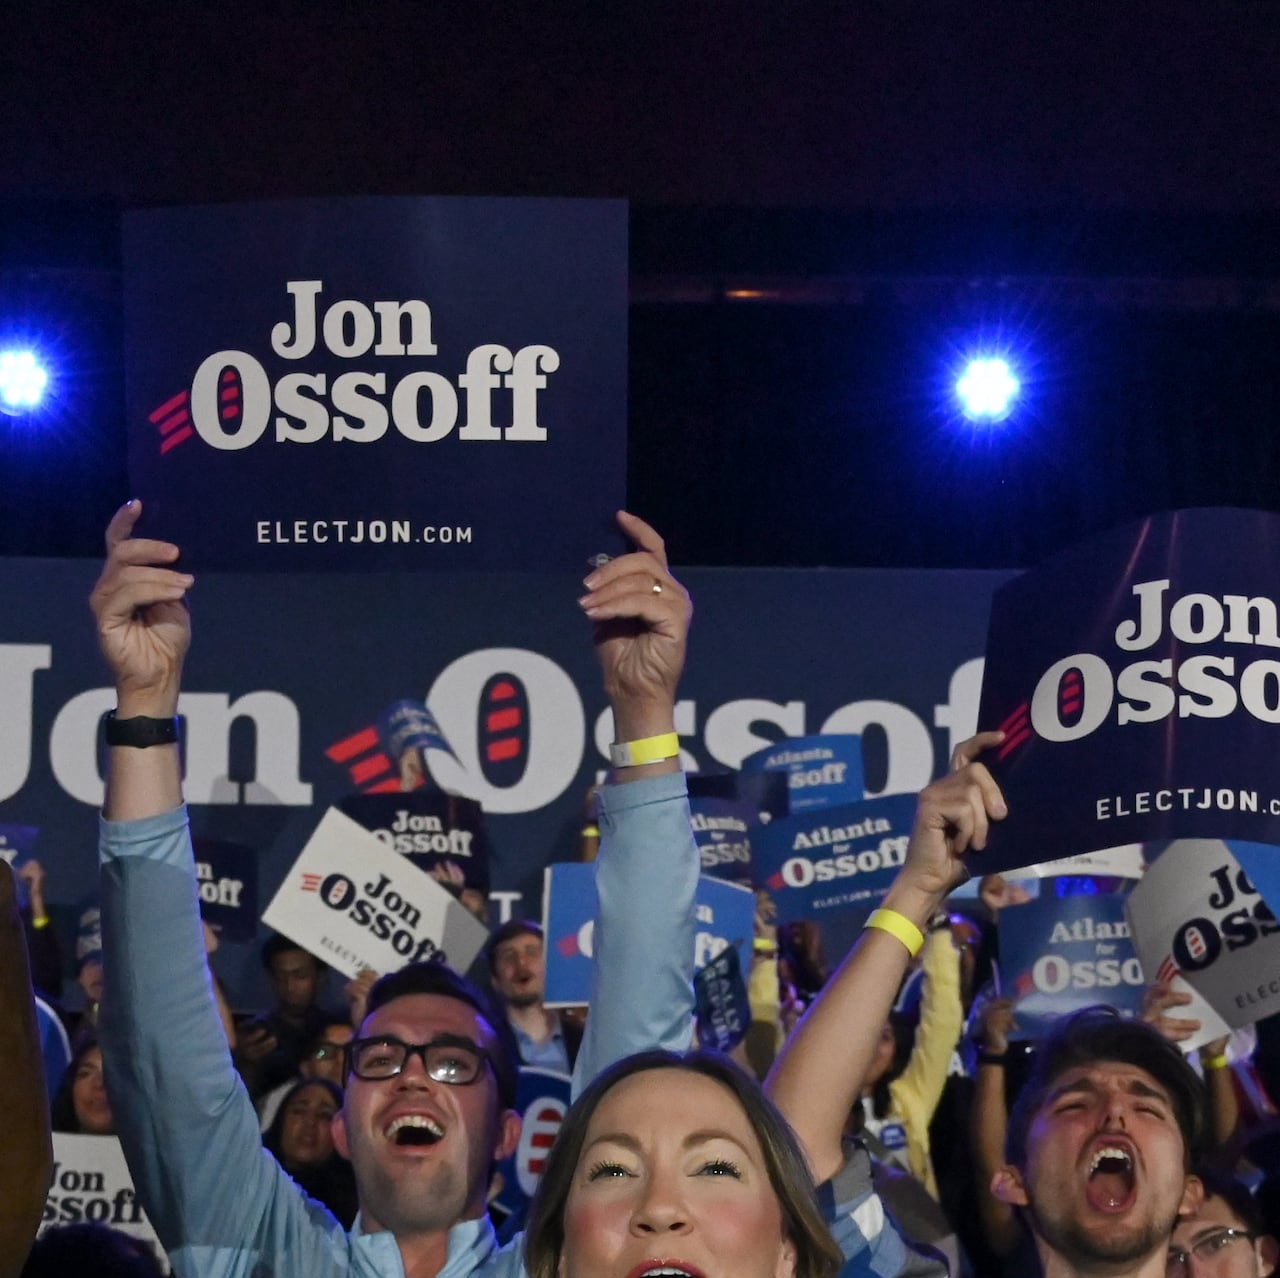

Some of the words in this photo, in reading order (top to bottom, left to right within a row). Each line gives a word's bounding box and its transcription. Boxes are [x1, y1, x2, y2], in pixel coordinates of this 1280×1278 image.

[271, 280, 438, 360] Jon
[190, 343, 561, 450] Ossoff
[256, 520, 473, 544] ELECTJON.COM
[788, 762, 848, 789] soff
[391, 810, 443, 832] Jon
[690, 813, 747, 833] tlanta
[792, 817, 892, 850] Atlanta
[363, 872, 421, 929] Jon
[319, 872, 447, 964] Ossof
[1048, 917, 1131, 944] Atlan
[1032, 955, 1145, 993] Osso
